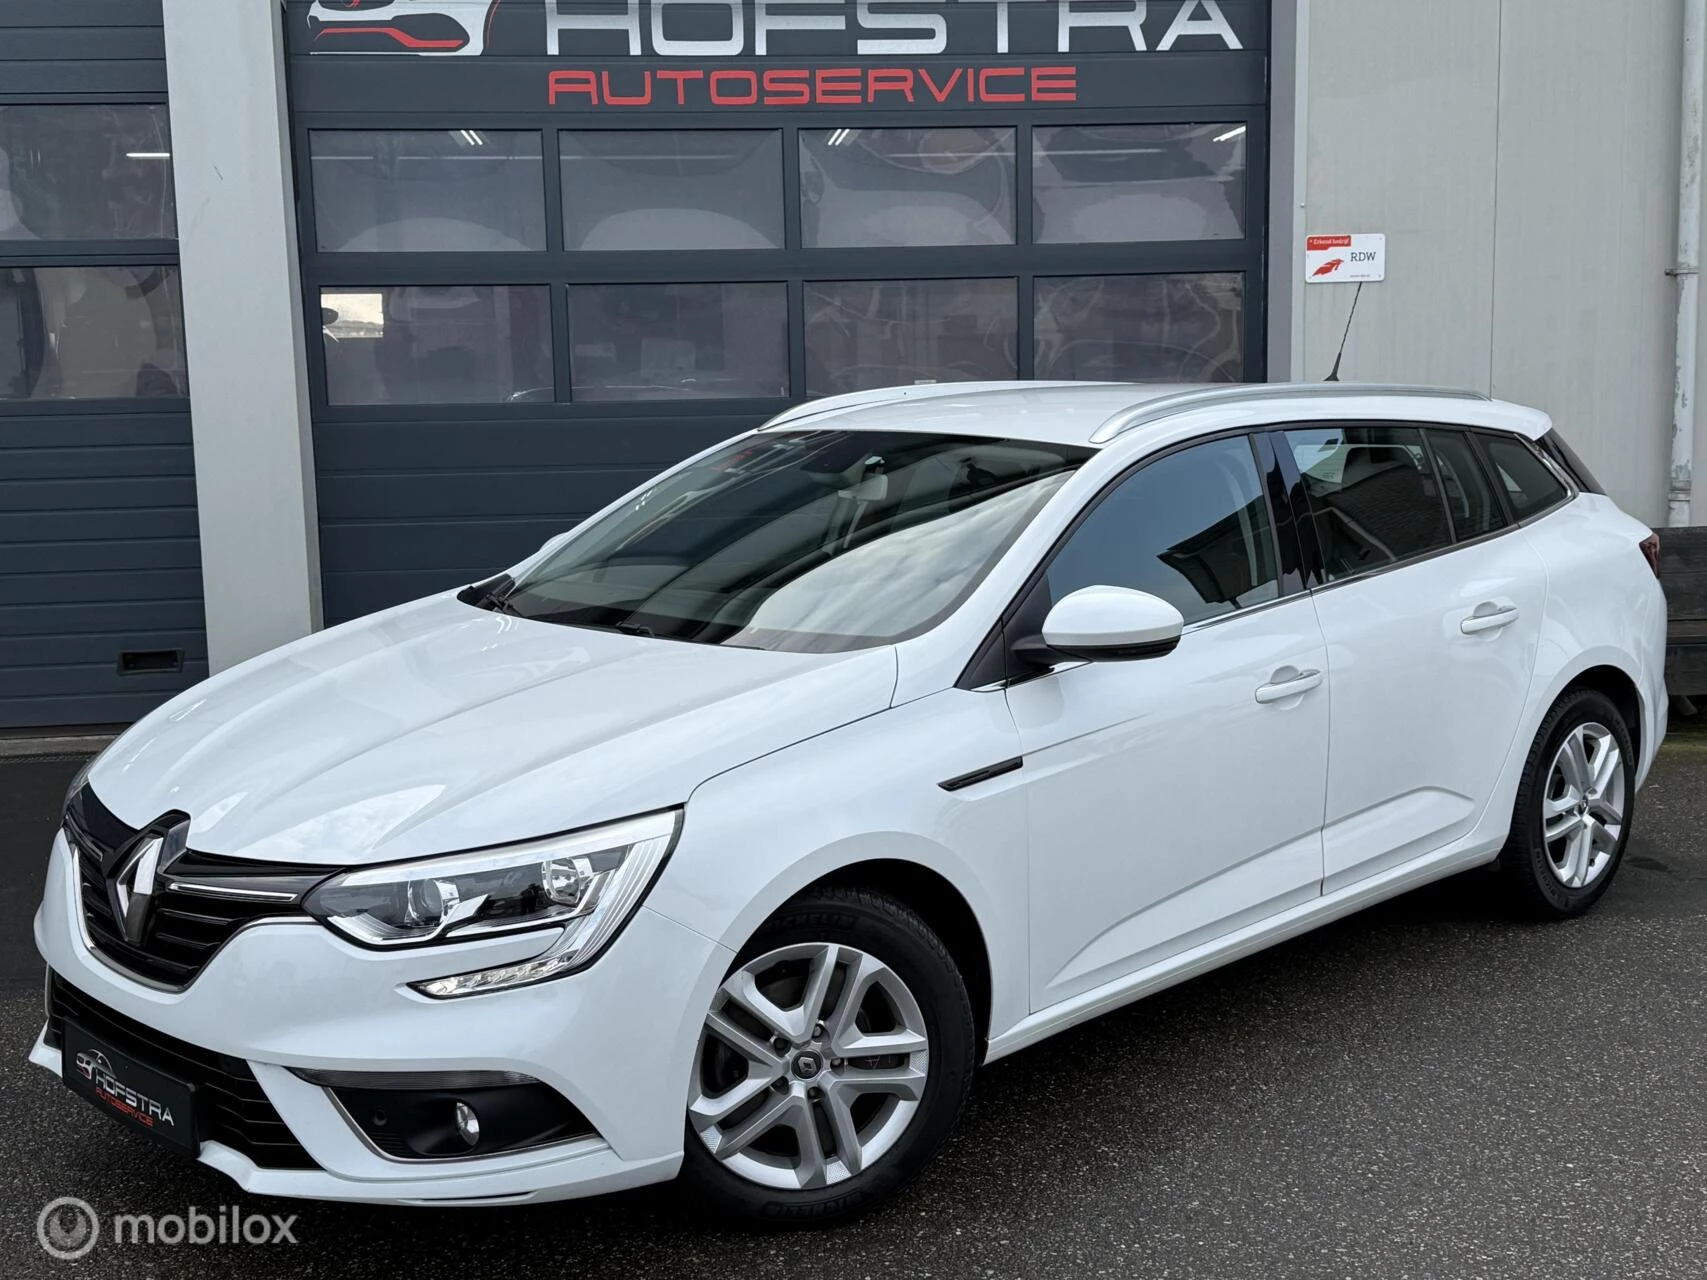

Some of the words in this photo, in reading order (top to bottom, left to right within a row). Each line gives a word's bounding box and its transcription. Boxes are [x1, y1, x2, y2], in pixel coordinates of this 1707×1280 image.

[545, 0, 1244, 55] HOFSTRA
[548, 66, 1077, 106] AUTOSERVICE
[1350, 251, 1377, 262] RDW
[95, 1068, 175, 1127] HOFSTRA
[95, 1086, 154, 1129] AUTOSERVICE
